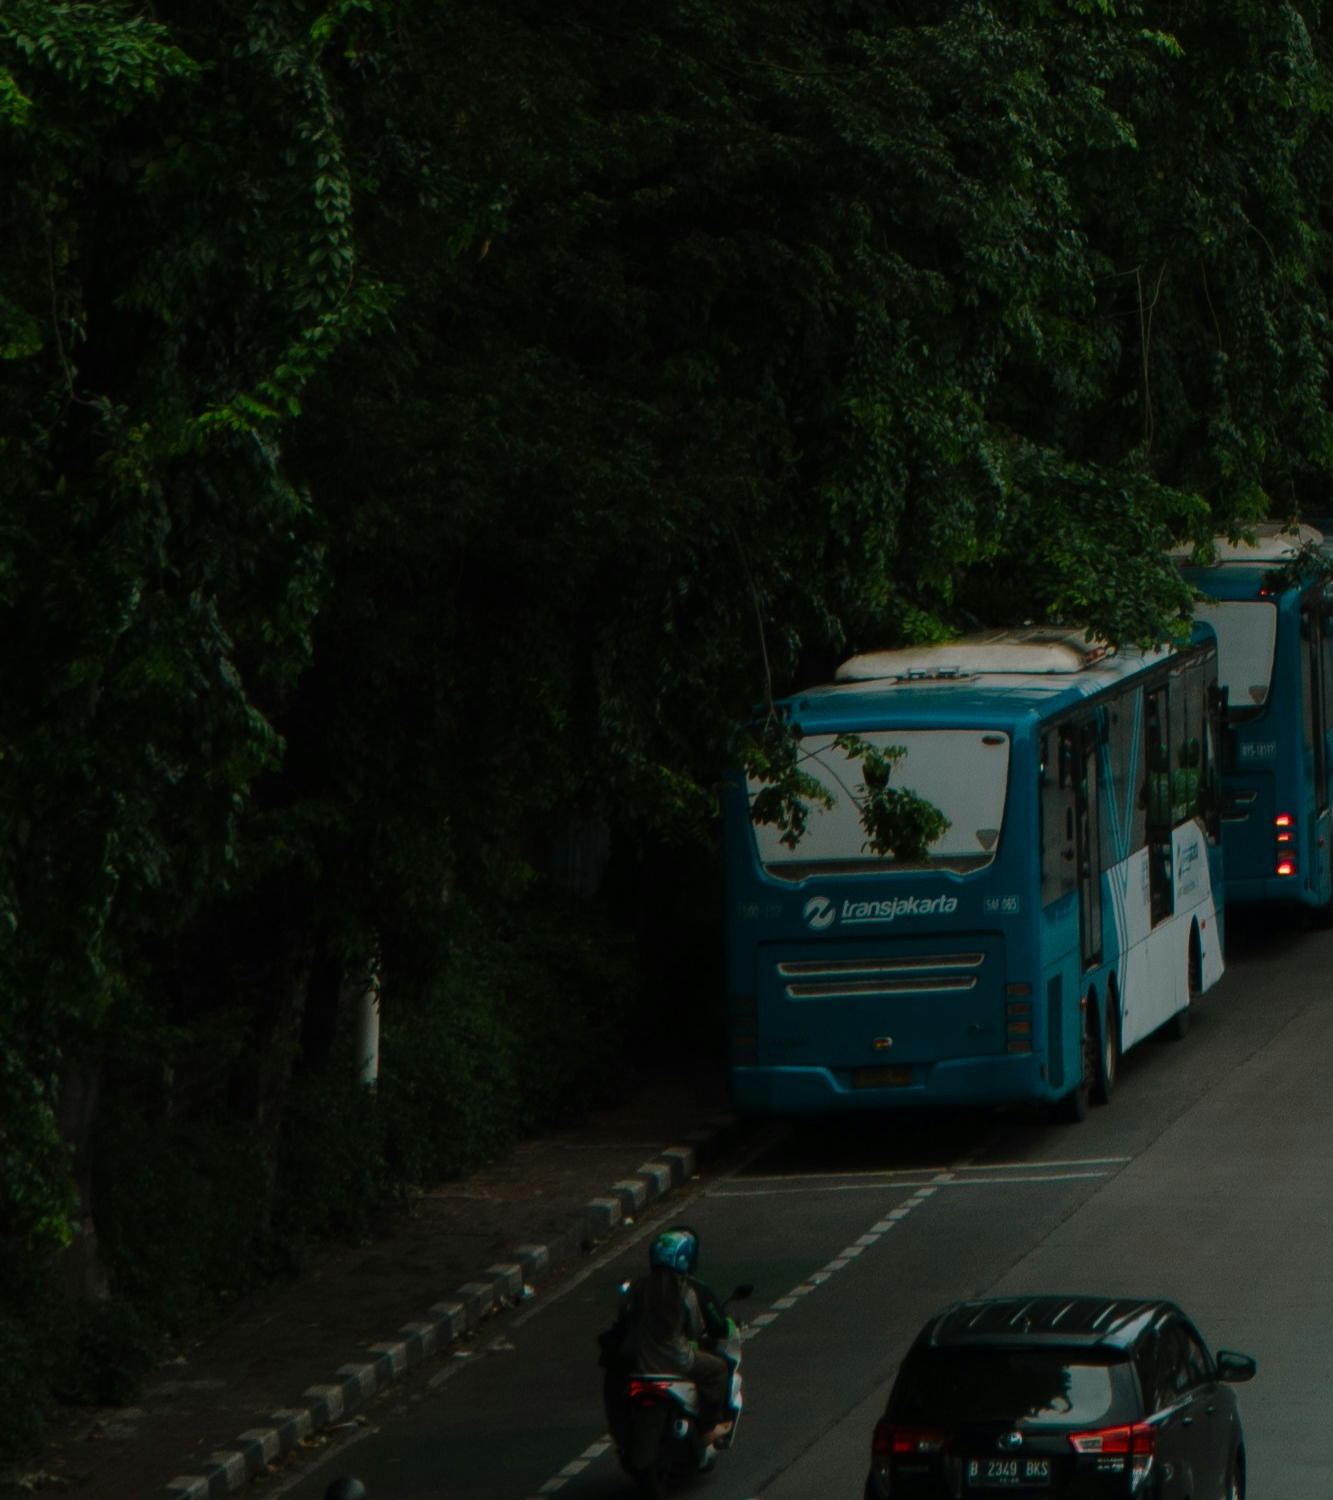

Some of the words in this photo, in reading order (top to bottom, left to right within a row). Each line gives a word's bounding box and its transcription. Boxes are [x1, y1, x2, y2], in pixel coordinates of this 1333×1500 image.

[840, 894, 958, 923] transjakarta
[970, 1460, 978, 1476] B
[988, 1460, 1017, 1477] 2349
[1026, 1460, 1049, 1477] BKS
